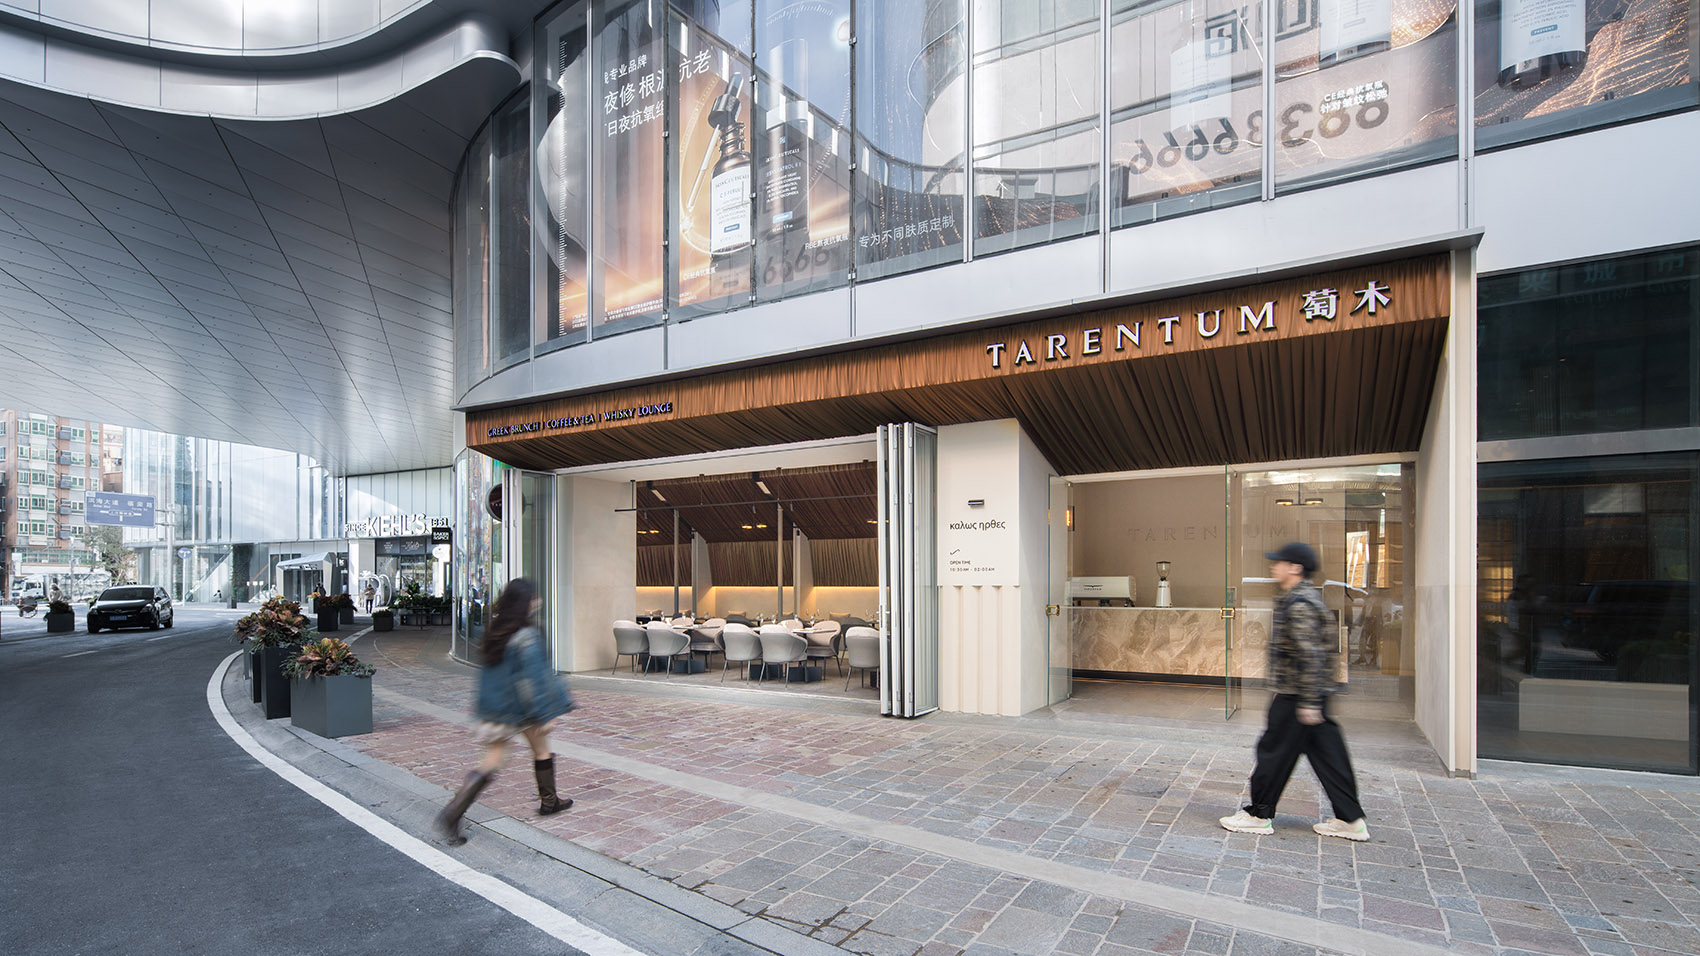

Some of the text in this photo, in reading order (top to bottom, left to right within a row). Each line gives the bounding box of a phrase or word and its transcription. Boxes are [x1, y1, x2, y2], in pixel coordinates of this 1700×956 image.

[858, 214, 955, 248] 专为不同肤质定制
[986, 280, 1391, 368] TARENTUM 萄木
[487, 427, 510, 437] GREEK
[510, 422, 540, 434] BRUNCH
[603, 408, 636, 421] WHISKY
[637, 402, 673, 416] LOUNGE
[344, 523, 367, 533] SINCE
[366, 513, 427, 537] KIEHL'S
[949, 519, 1006, 531] καλως ηρθες
[1127, 525, 1289, 542] TARENUM
